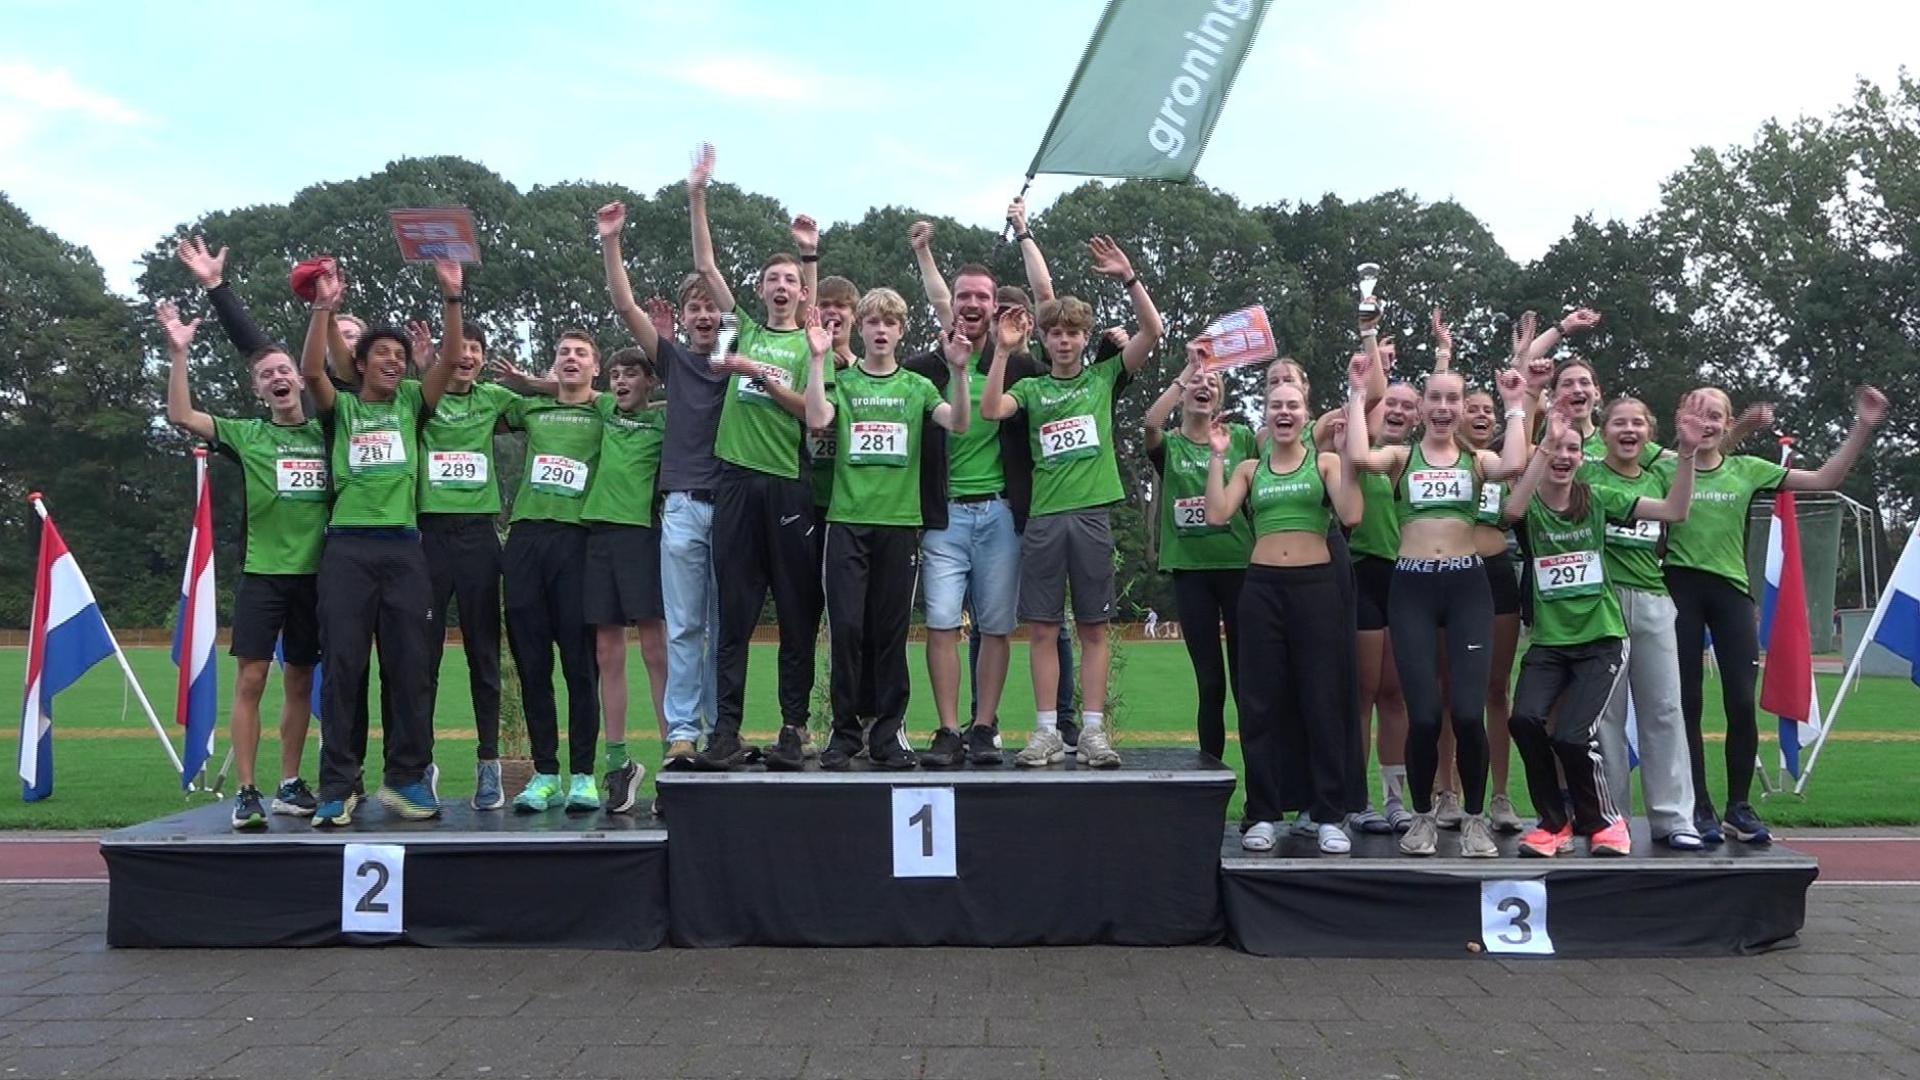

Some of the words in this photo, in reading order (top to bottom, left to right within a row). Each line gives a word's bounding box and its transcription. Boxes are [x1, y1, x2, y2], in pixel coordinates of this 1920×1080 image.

[852, 396, 906, 408] groningen
[863, 424, 894, 433] SPAR
[1050, 419, 1081, 432] SPAR
[815, 440, 838, 457] 28
[860, 434, 895, 452] 281
[1051, 429, 1088, 452] 282
[359, 443, 393, 462] 287
[290, 471, 327, 489] 285
[441, 463, 476, 479] 289
[540, 466, 576, 485] 290
[1258, 482, 1311, 497] groningen
[1421, 481, 1461, 500] 294
[1691, 491, 1737, 502] ningen
[1184, 508, 1206, 525] 29
[1395, 557, 1436, 573] NIKE
[1438, 555, 1472, 573] PRO
[1549, 554, 1584, 567] SPAR
[1549, 564, 1588, 586] 297
[908, 804, 933, 857] 1
[354, 860, 389, 913] 2
[1497, 896, 1532, 945] 3
